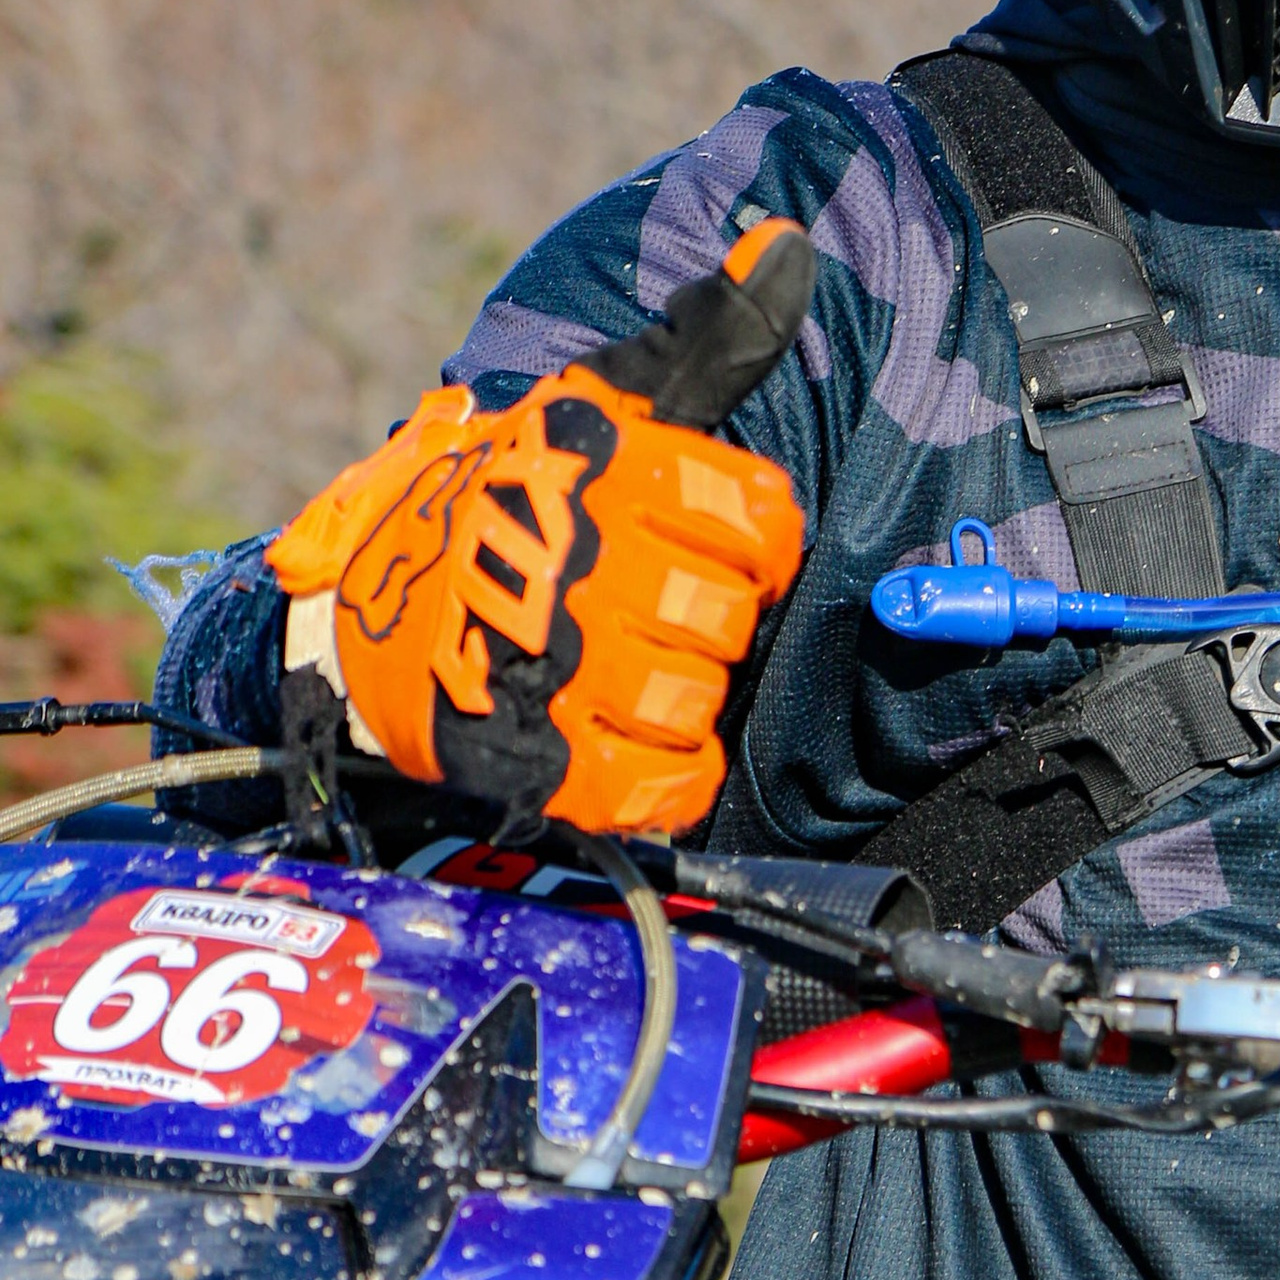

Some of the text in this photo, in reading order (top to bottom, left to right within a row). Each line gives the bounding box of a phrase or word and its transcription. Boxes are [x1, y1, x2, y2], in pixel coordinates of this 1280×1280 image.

[430, 407, 592, 715] FOX
[161, 903, 271, 931] КВАДРО
[53, 935, 310, 1073] 66
